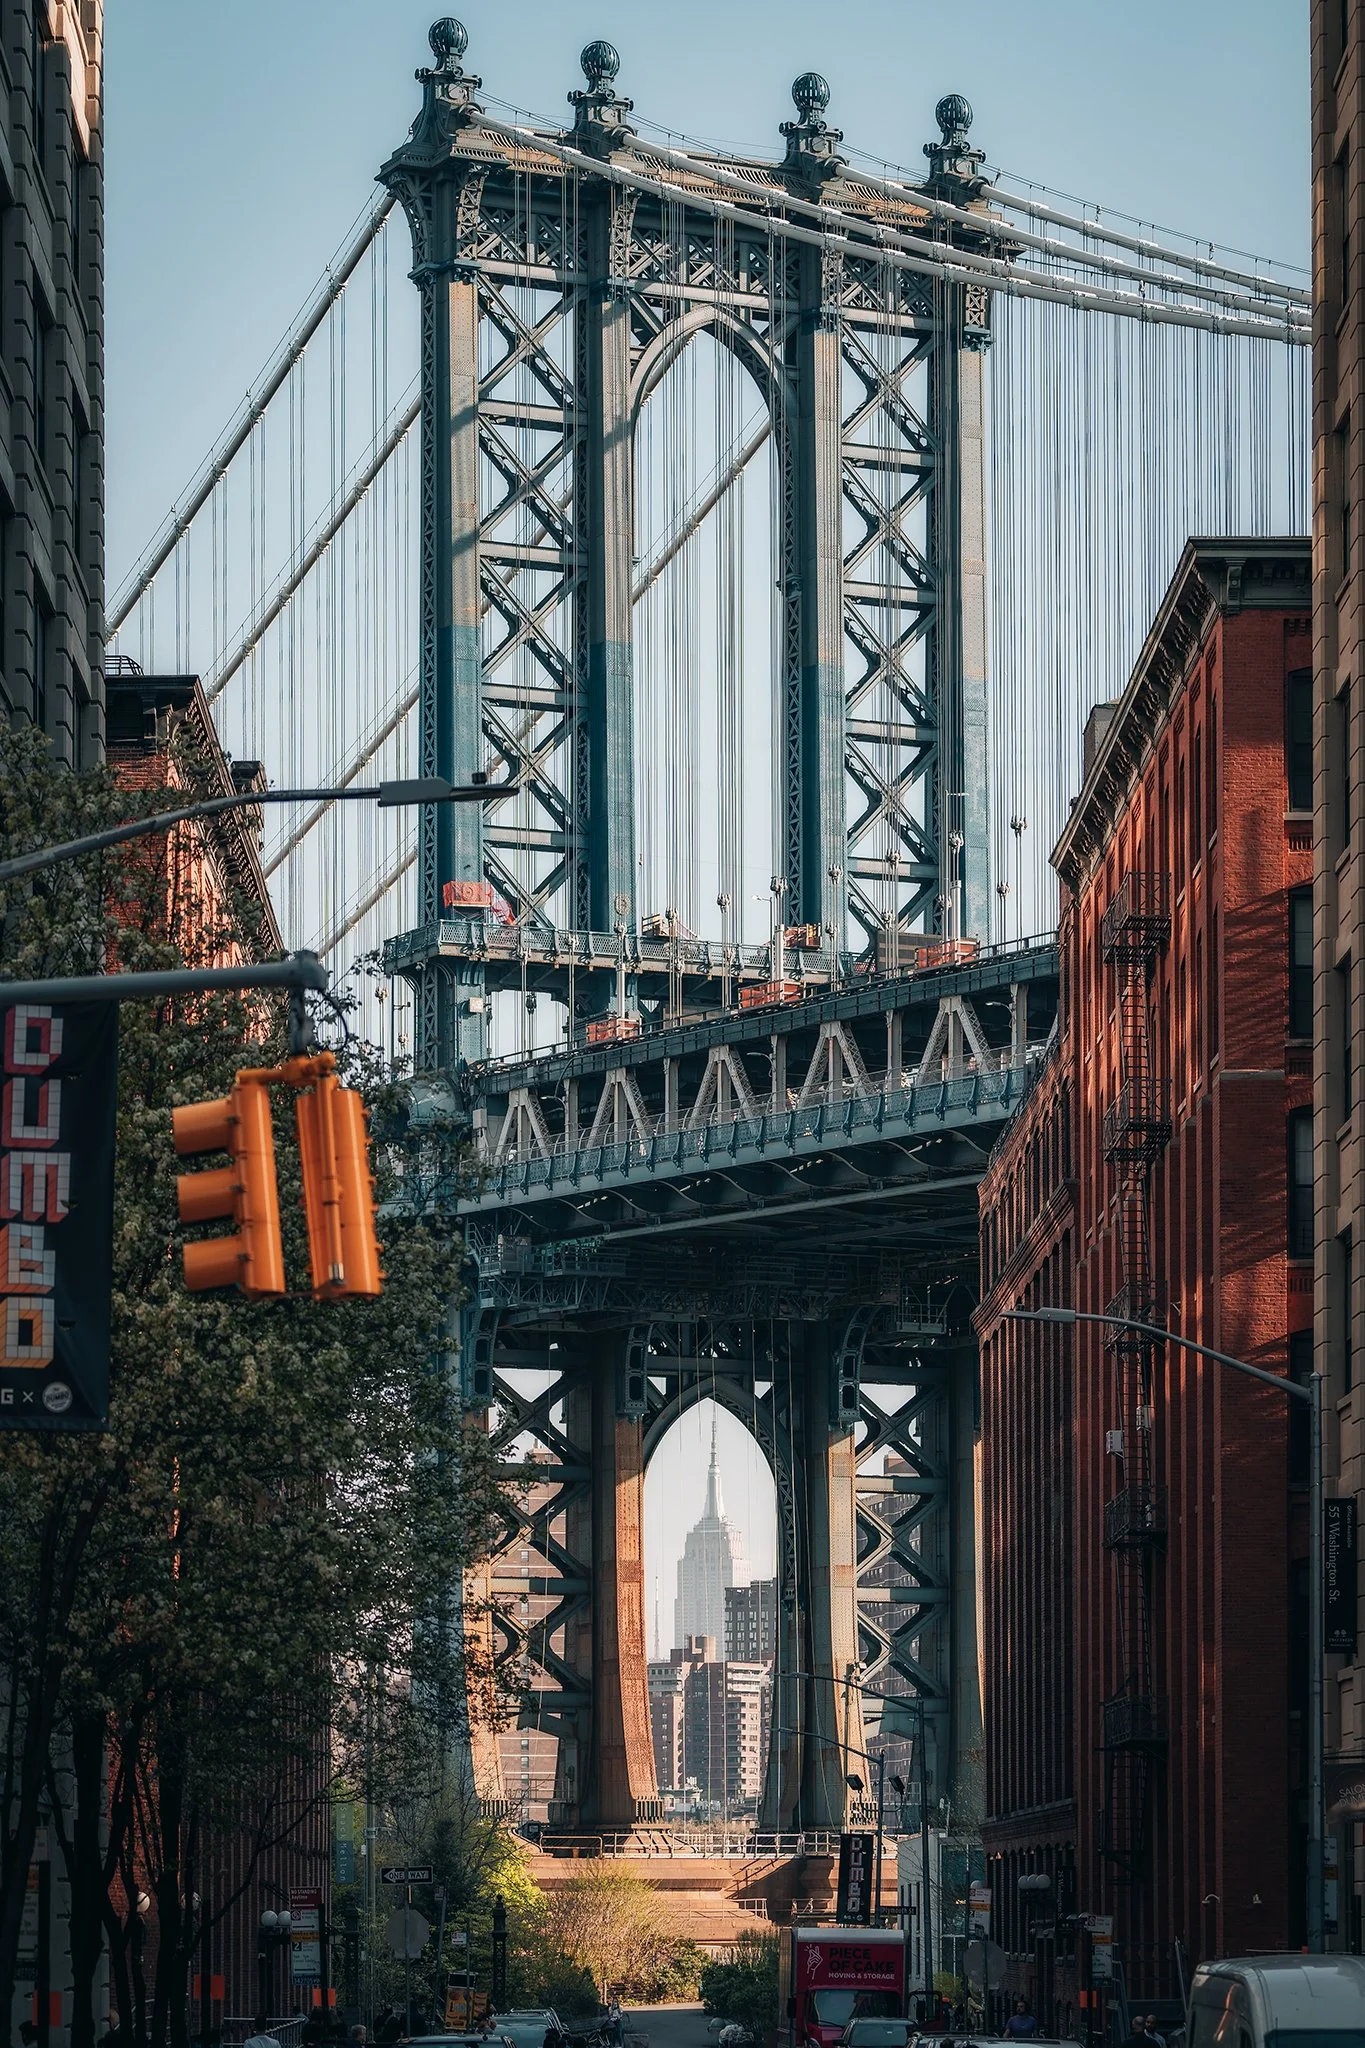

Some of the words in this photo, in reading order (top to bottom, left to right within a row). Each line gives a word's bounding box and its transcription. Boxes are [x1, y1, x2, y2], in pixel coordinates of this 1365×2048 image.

[0, 1004, 71, 1369] DUMBO
[1328, 1505, 1340, 1518] 55
[1326, 1521, 1340, 1586] Washington
[1328, 1589, 1340, 1604] St.
[847, 1837, 864, 1912] DUMBO
[294, 1942, 300, 1951] 2
[830, 1947, 871, 1959] PIECE
[829, 1960, 850, 1971] OF
[853, 1960, 895, 1972] CAKE
